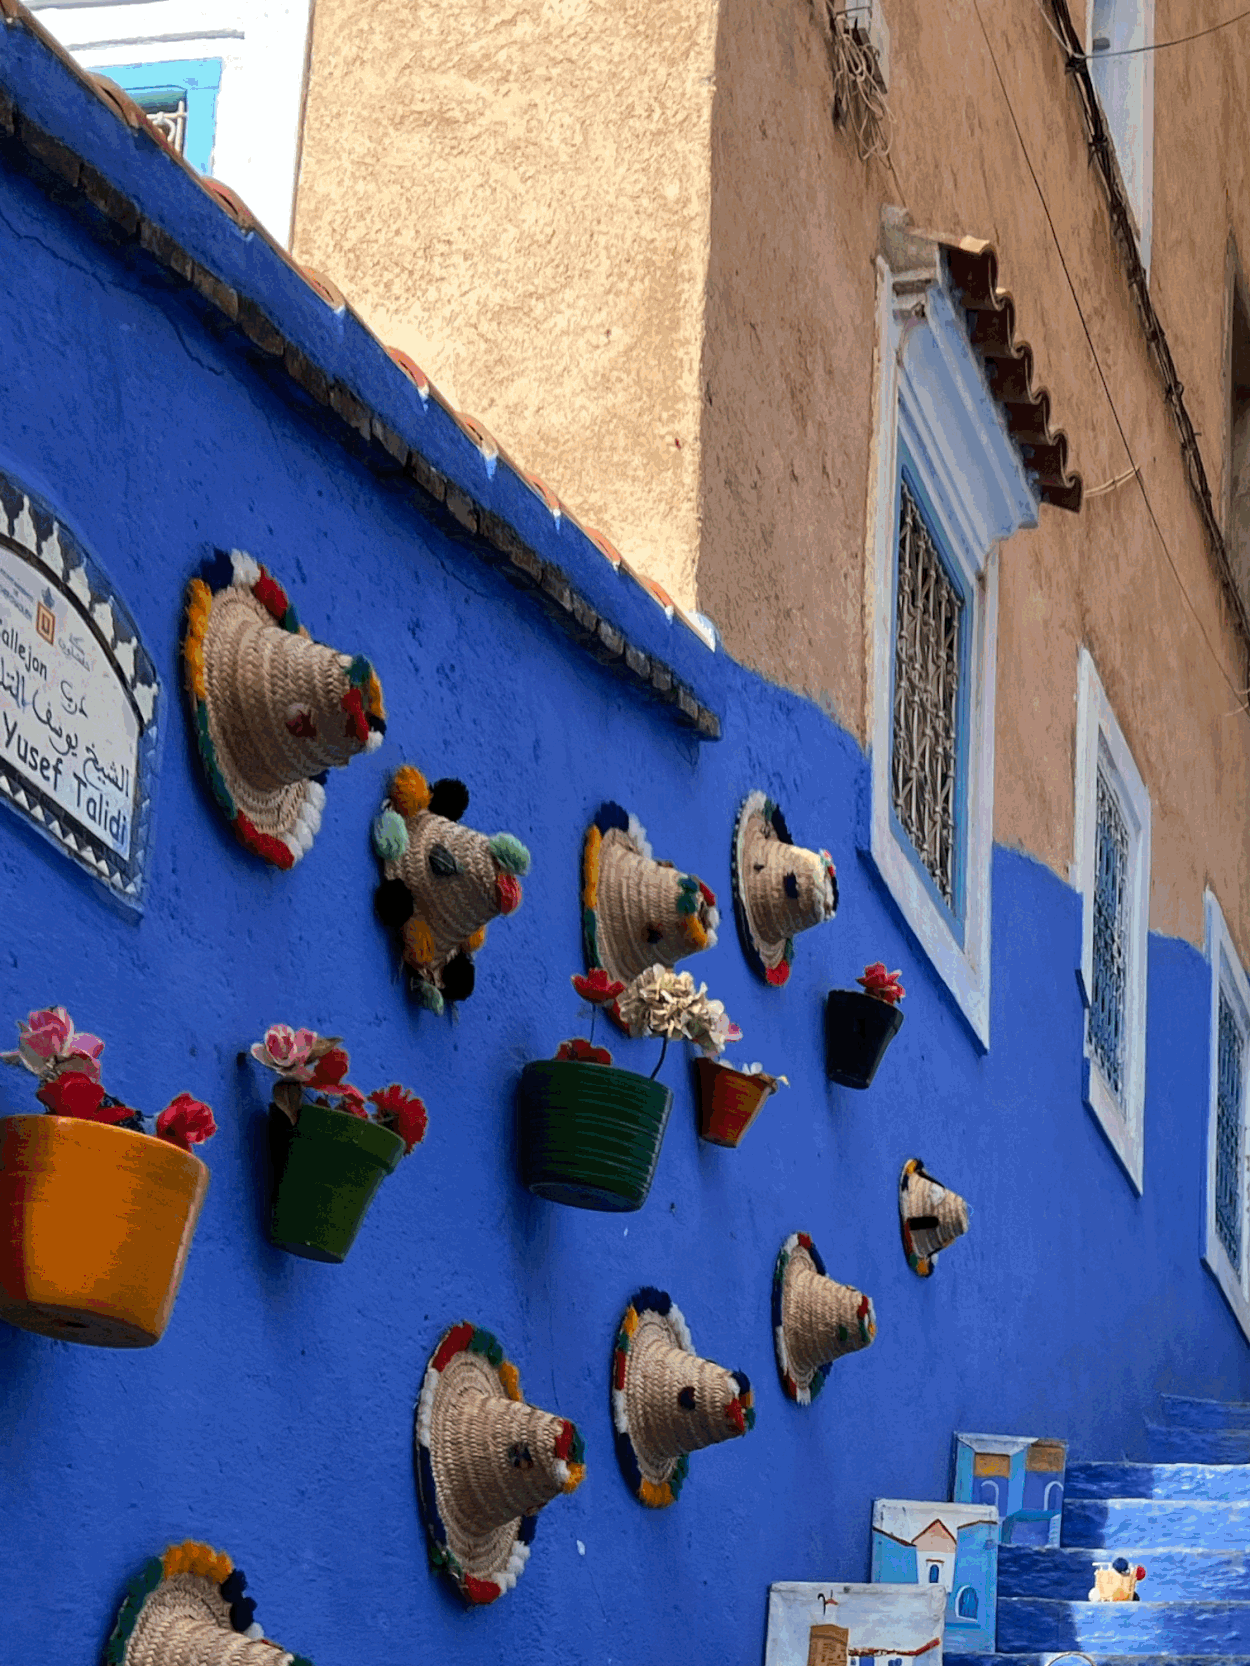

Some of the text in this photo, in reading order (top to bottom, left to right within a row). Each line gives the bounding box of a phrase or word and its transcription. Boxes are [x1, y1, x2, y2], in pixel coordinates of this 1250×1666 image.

[32, 689, 78, 758] يوسف
[3, 712, 126, 847] Yusef Talidi
[83, 744, 128, 798] الشيخ
